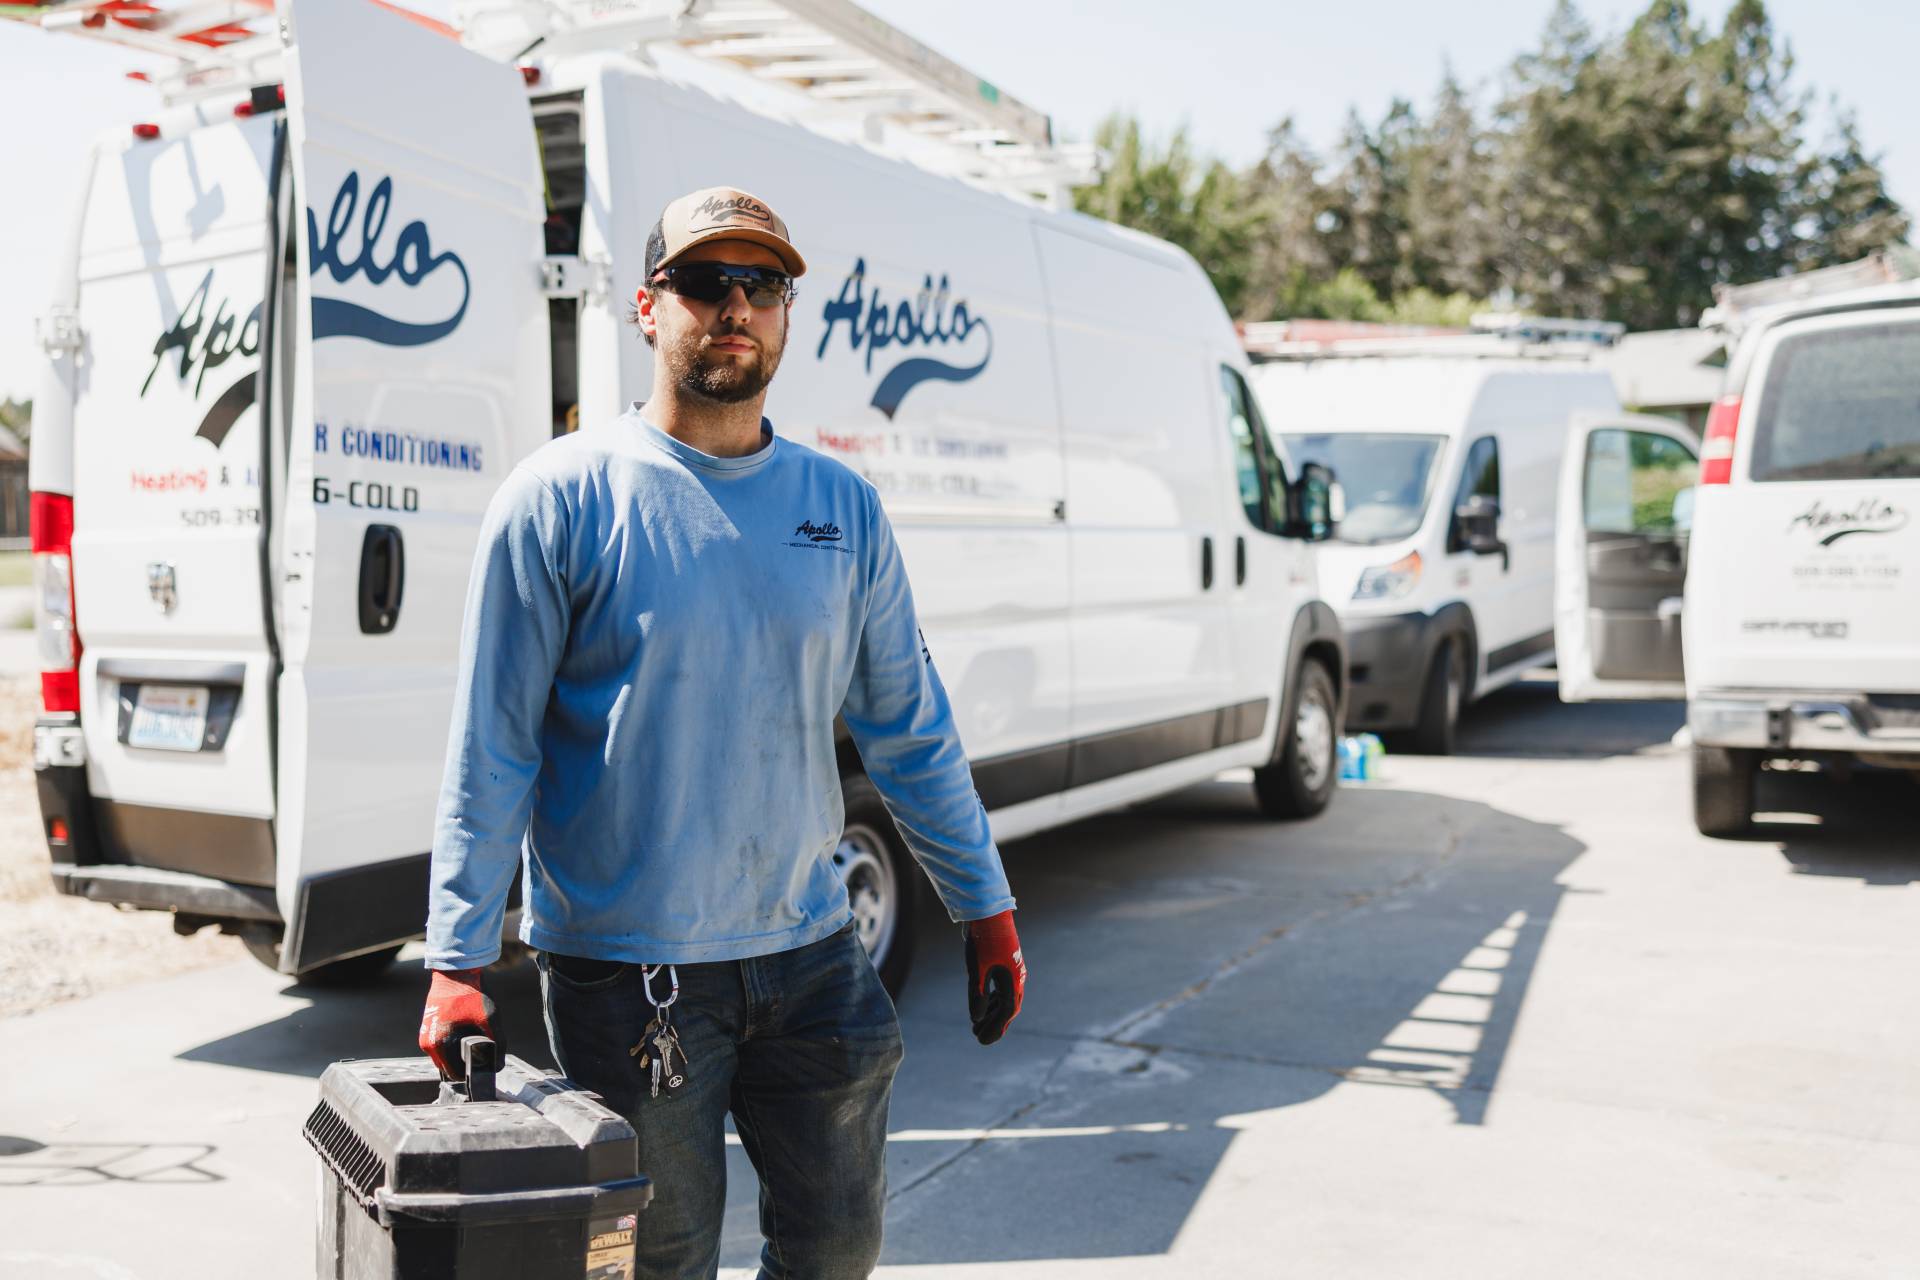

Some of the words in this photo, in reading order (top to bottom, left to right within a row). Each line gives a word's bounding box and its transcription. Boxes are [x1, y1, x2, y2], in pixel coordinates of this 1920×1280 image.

[691, 196, 769, 222] Apollo
[307, 171, 470, 287] llo
[817, 257, 992, 374] Apollo
[342, 427, 482, 472] CONDITIONING
[131, 467, 208, 493] Heating
[313, 477, 418, 513] 6-COLD
[795, 520, 842, 540] Apollo
[1786, 499, 1908, 537] Apollo
